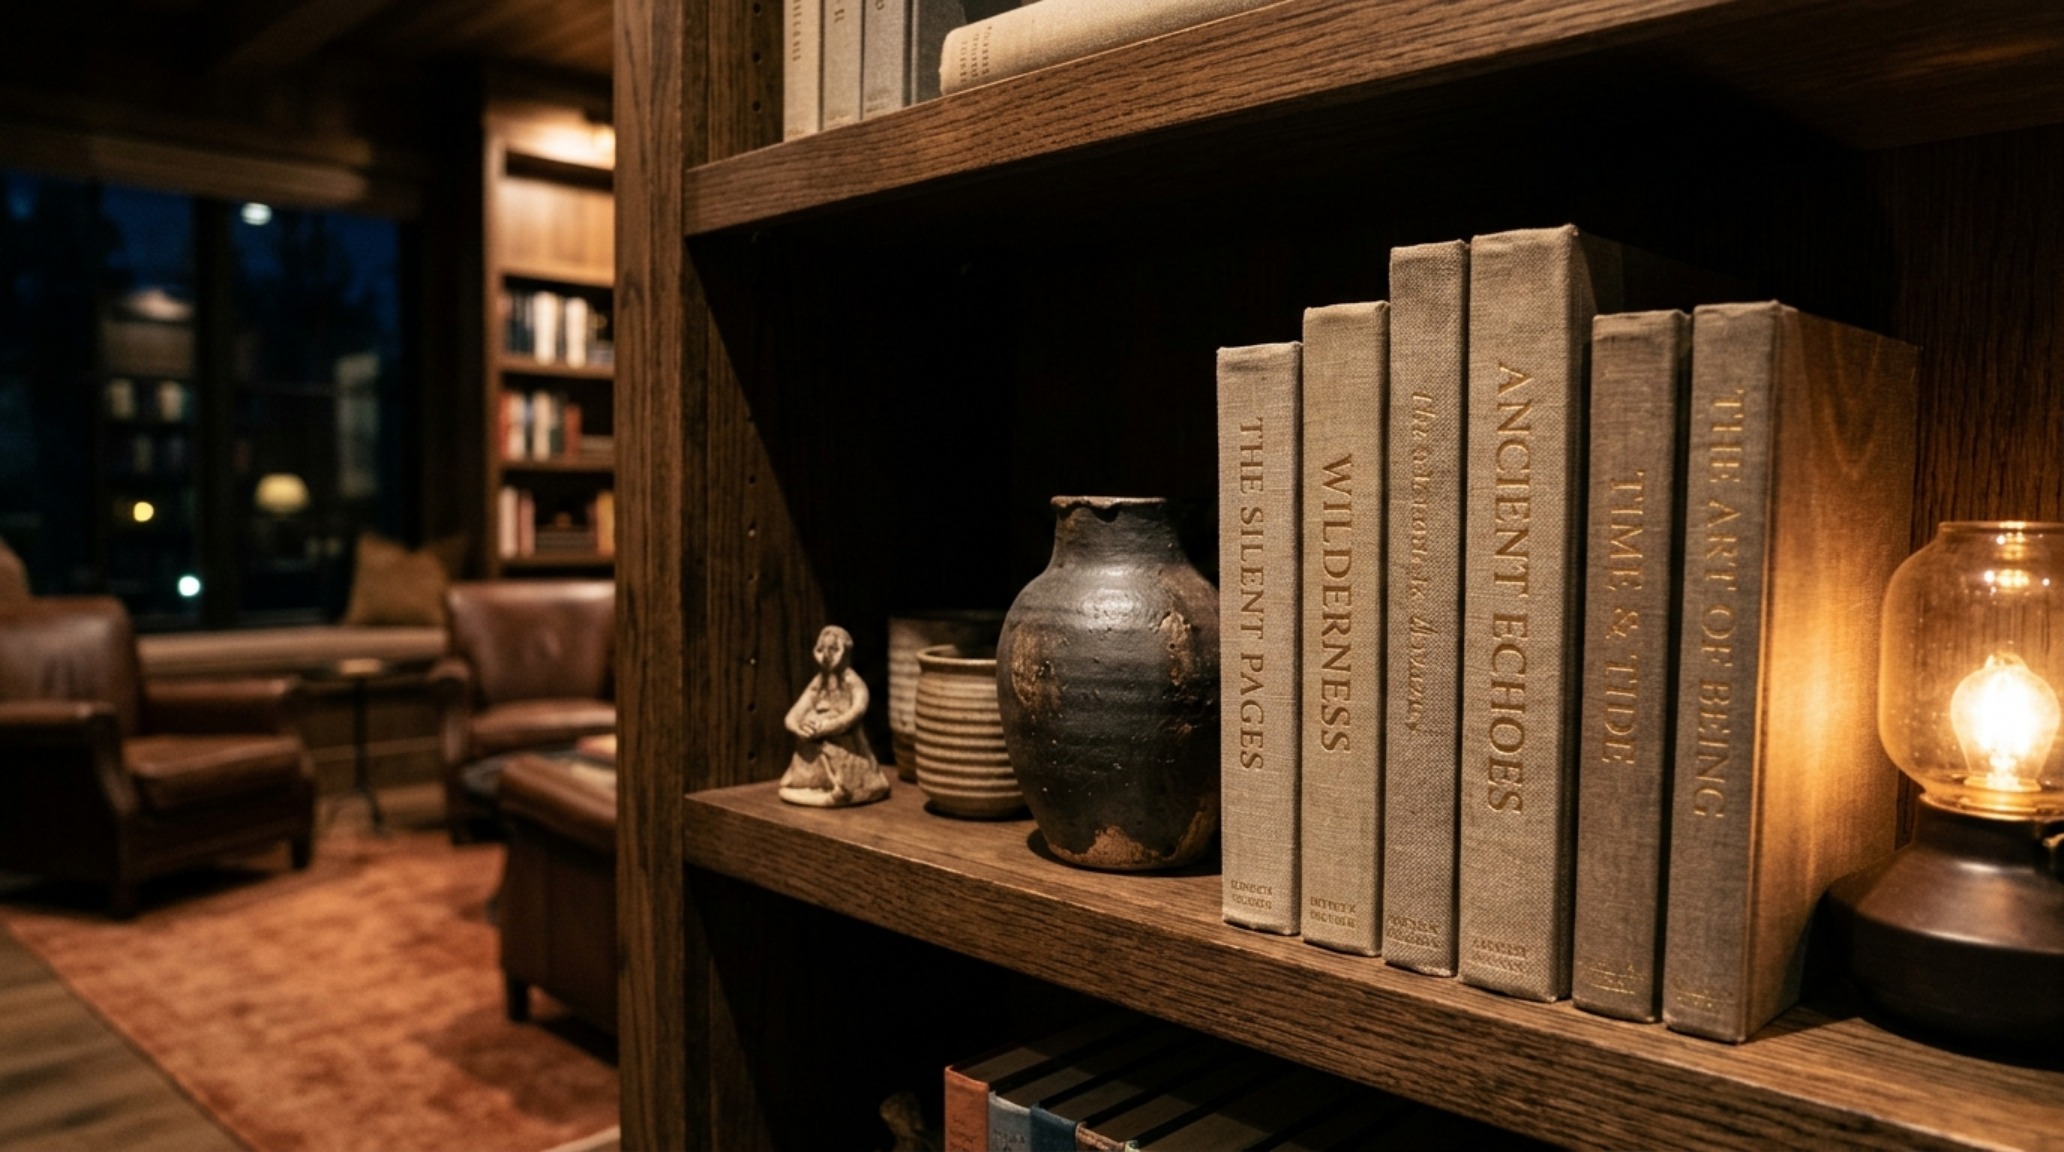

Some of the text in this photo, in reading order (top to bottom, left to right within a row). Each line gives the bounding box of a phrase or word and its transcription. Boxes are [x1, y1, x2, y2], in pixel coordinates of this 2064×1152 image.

[1239, 416, 1264, 770] THE SILENT PAGES
[1321, 453, 1353, 752] WILDERNESS
[1487, 362, 1534, 815] ANCIENT ECHOES
[1602, 468, 1645, 765] TIME & TIDE
[1694, 388, 1745, 819] THE ART OF BEING
